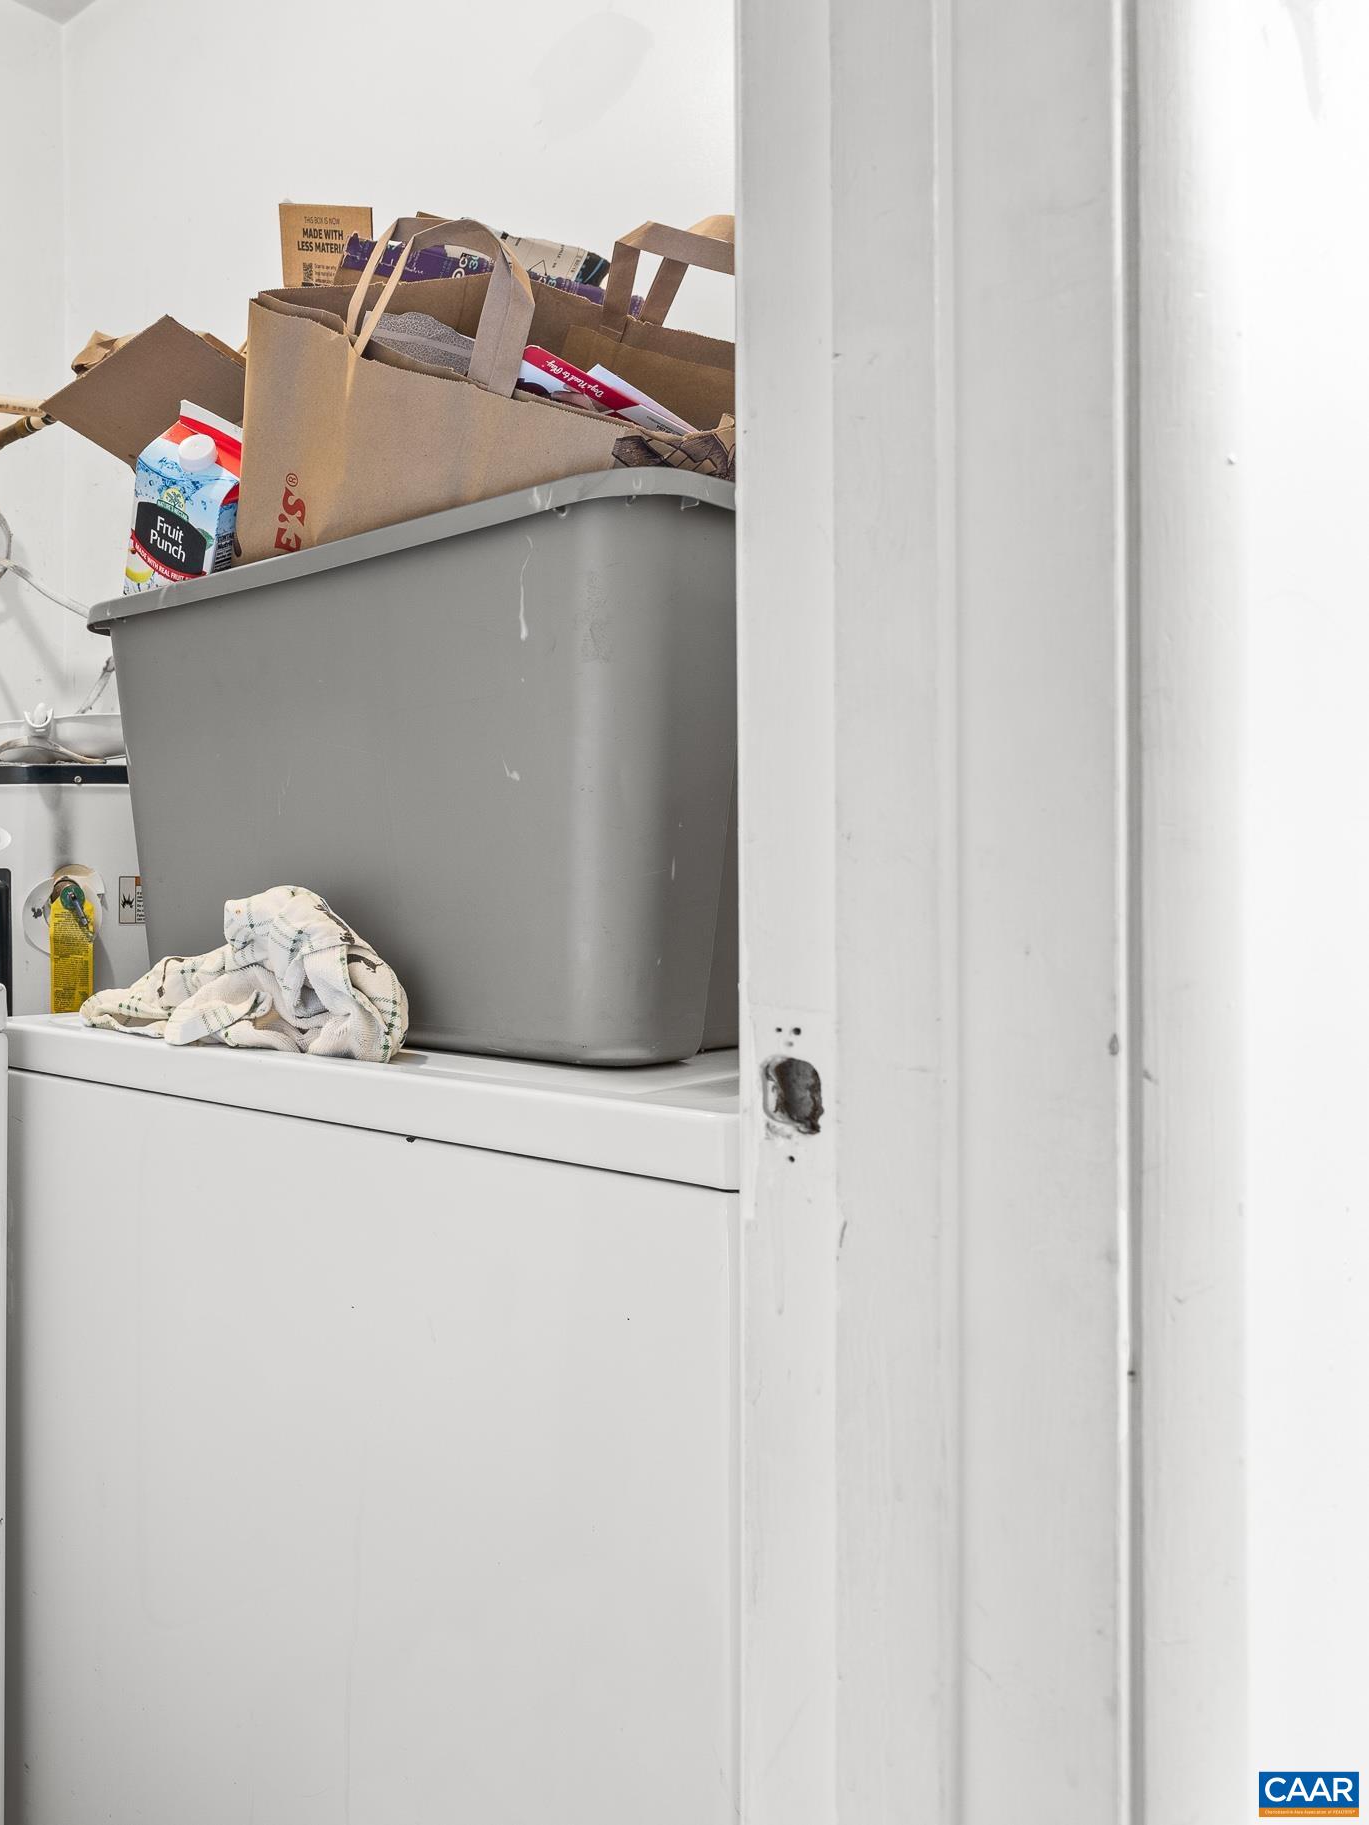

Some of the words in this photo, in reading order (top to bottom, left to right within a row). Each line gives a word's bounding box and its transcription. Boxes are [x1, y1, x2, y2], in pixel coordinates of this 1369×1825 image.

[303, 228, 323, 239] MADE
[324, 230, 344, 241] WITH
[314, 217, 323, 225] BOX
[297, 241, 314, 252] LESS
[315, 242, 344, 254] MATERIA
[157, 515, 184, 544] Fruit
[275, 487, 306, 551] E'S
[150, 529, 186, 563] Punch
[135, 542, 148, 559] MADE
[147, 557, 159, 569] WITH
[158, 564, 172, 576] REAL
[171, 571, 185, 581] FRUIT
